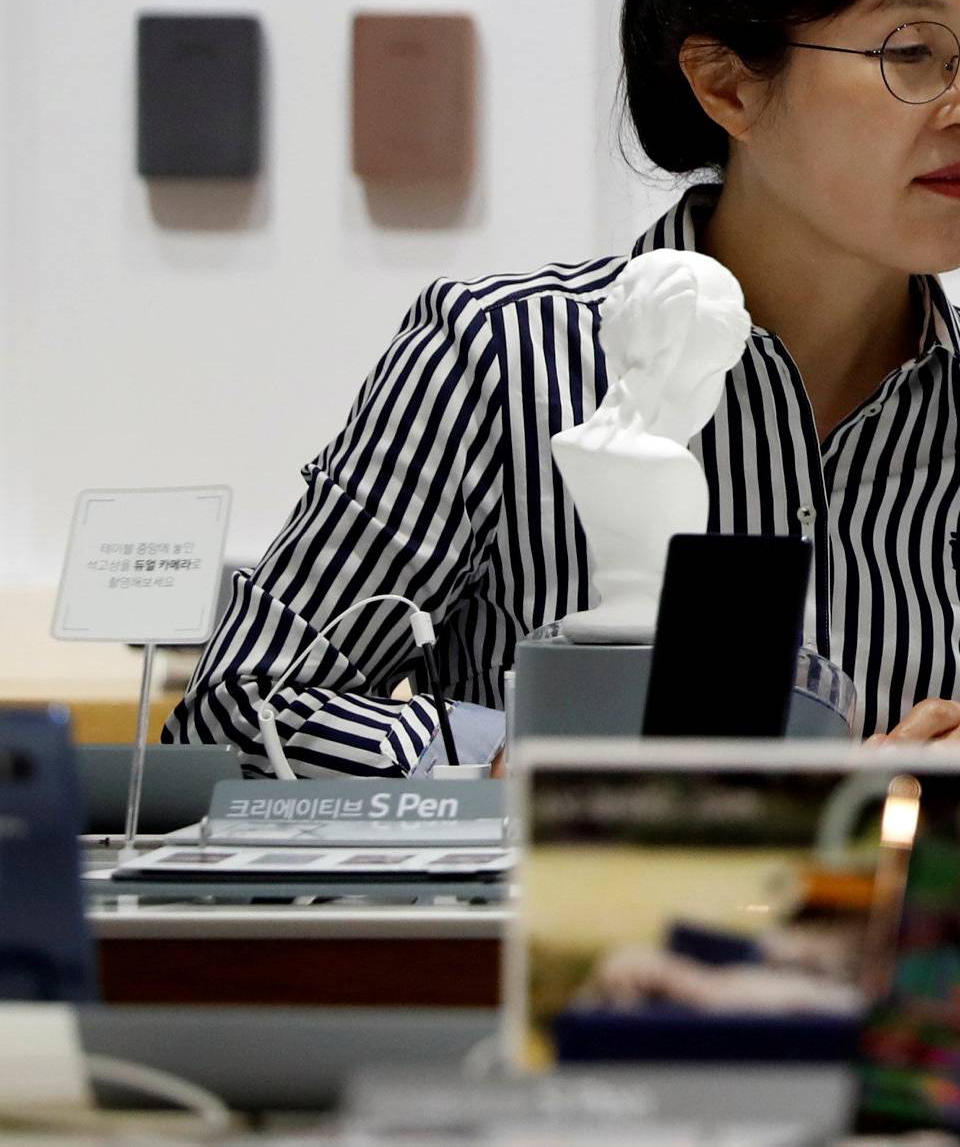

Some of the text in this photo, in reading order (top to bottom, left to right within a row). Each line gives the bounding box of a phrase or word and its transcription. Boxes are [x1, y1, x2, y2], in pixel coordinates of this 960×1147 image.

[133, 558, 156, 571] 듀얼
[226, 793, 459, 820] 크리에이티브 S Pen
